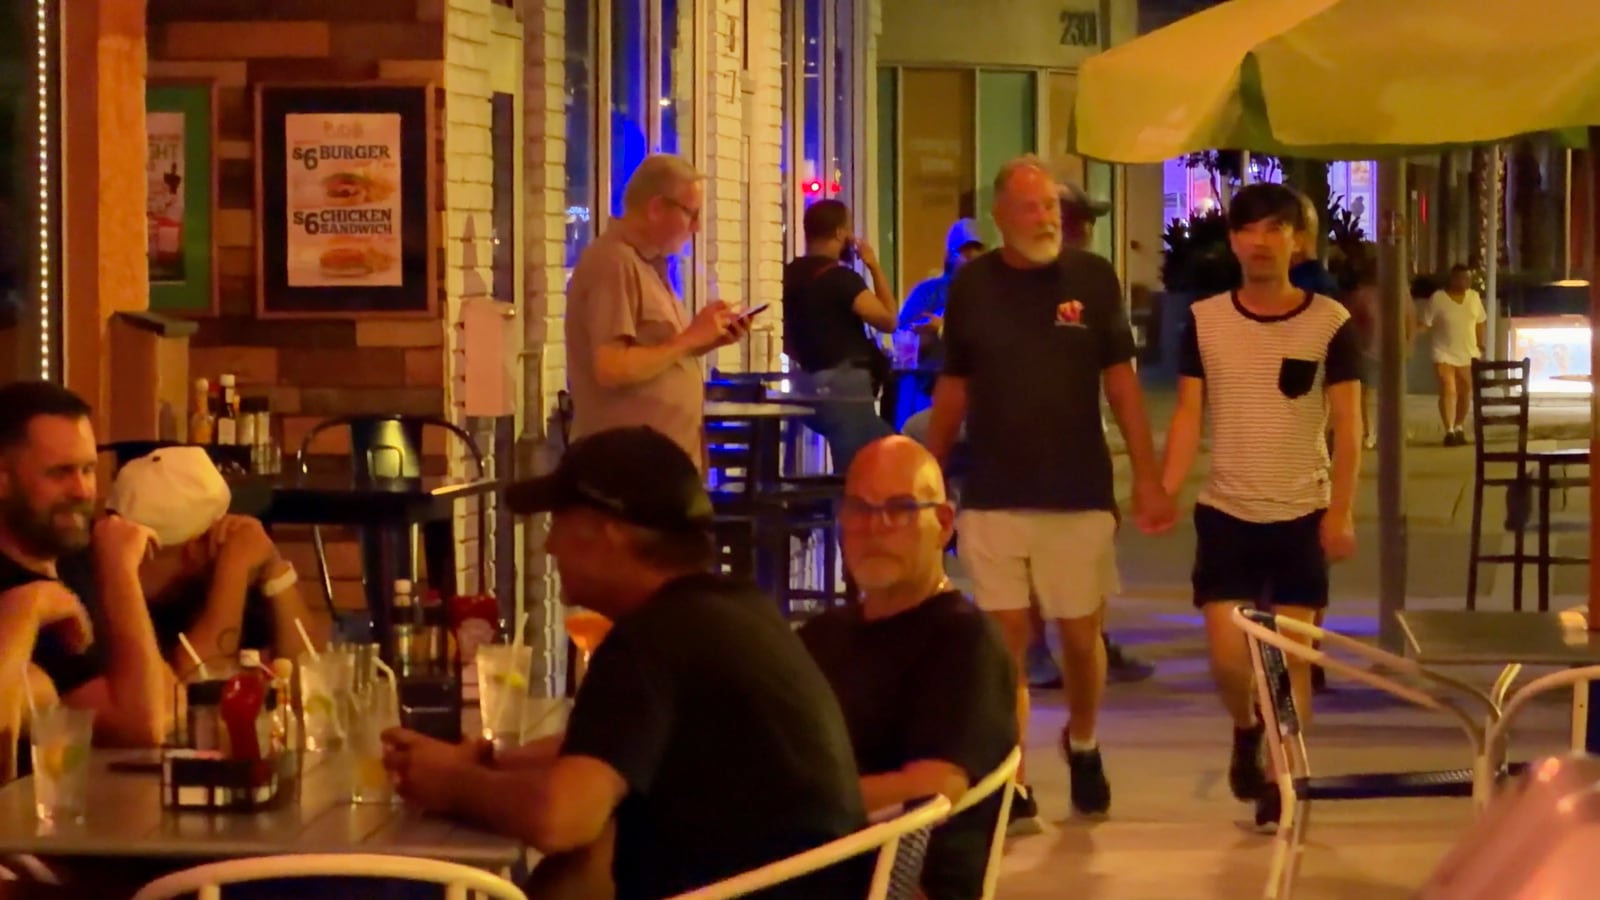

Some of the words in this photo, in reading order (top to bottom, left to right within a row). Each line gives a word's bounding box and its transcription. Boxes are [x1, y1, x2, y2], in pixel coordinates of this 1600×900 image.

[1059, 11, 1097, 47] 2301
[319, 145, 391, 160] BURGER
[320, 208, 392, 222] CHICKEN
[320, 223, 392, 235] SANDWICH
